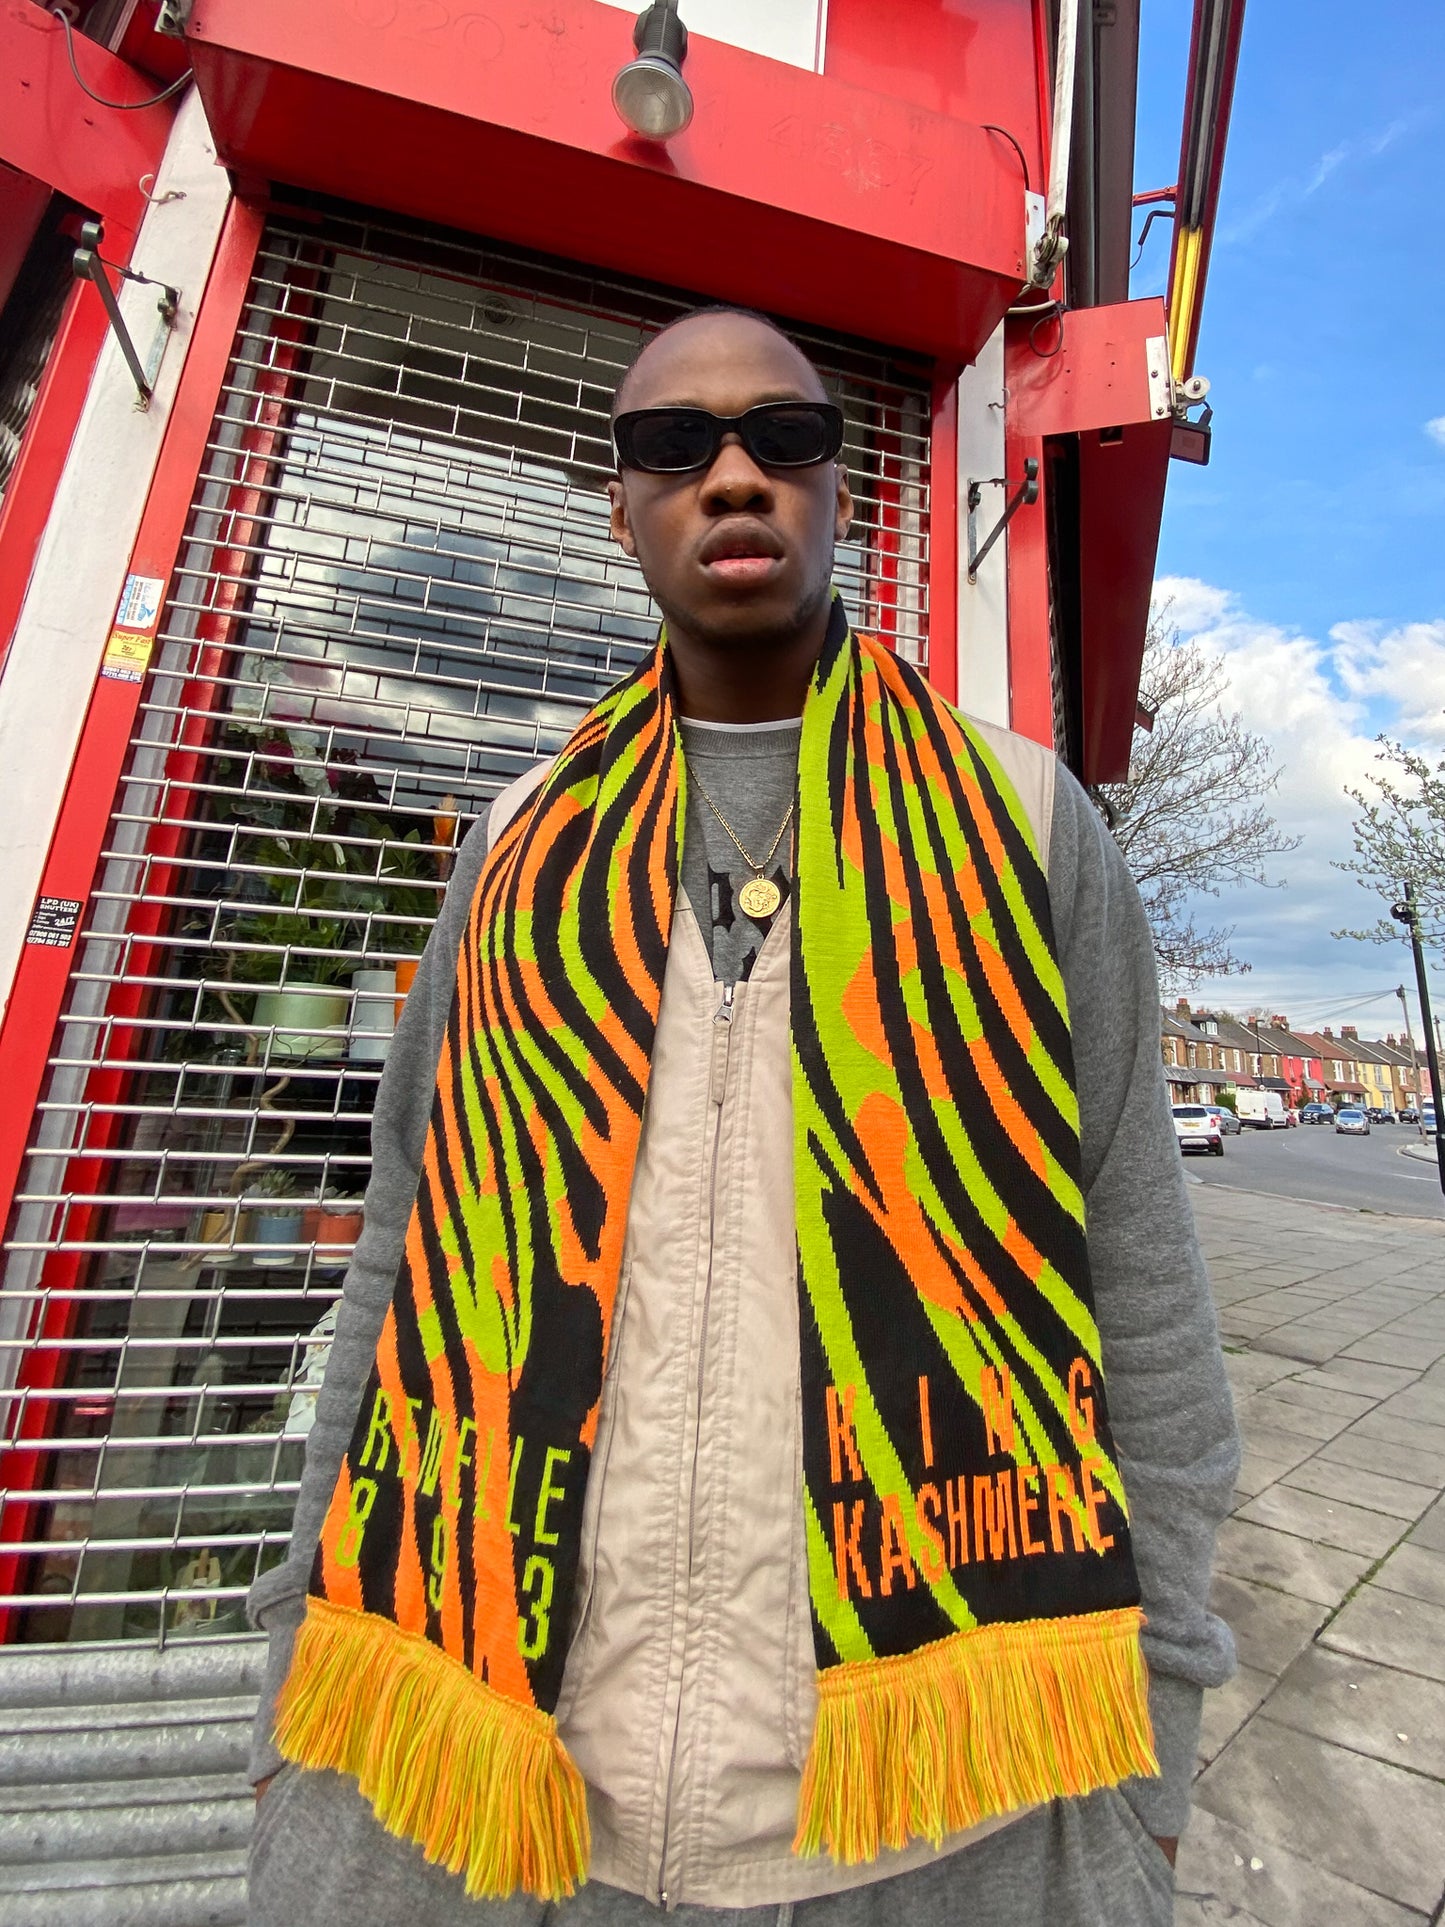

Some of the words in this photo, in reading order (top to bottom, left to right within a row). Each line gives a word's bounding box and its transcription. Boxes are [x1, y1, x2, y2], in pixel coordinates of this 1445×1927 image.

[40, 904, 78, 913] SHUTTERS
[825, 1357, 1095, 1484] KING
[833, 1457, 1115, 1601] KASHMERE
